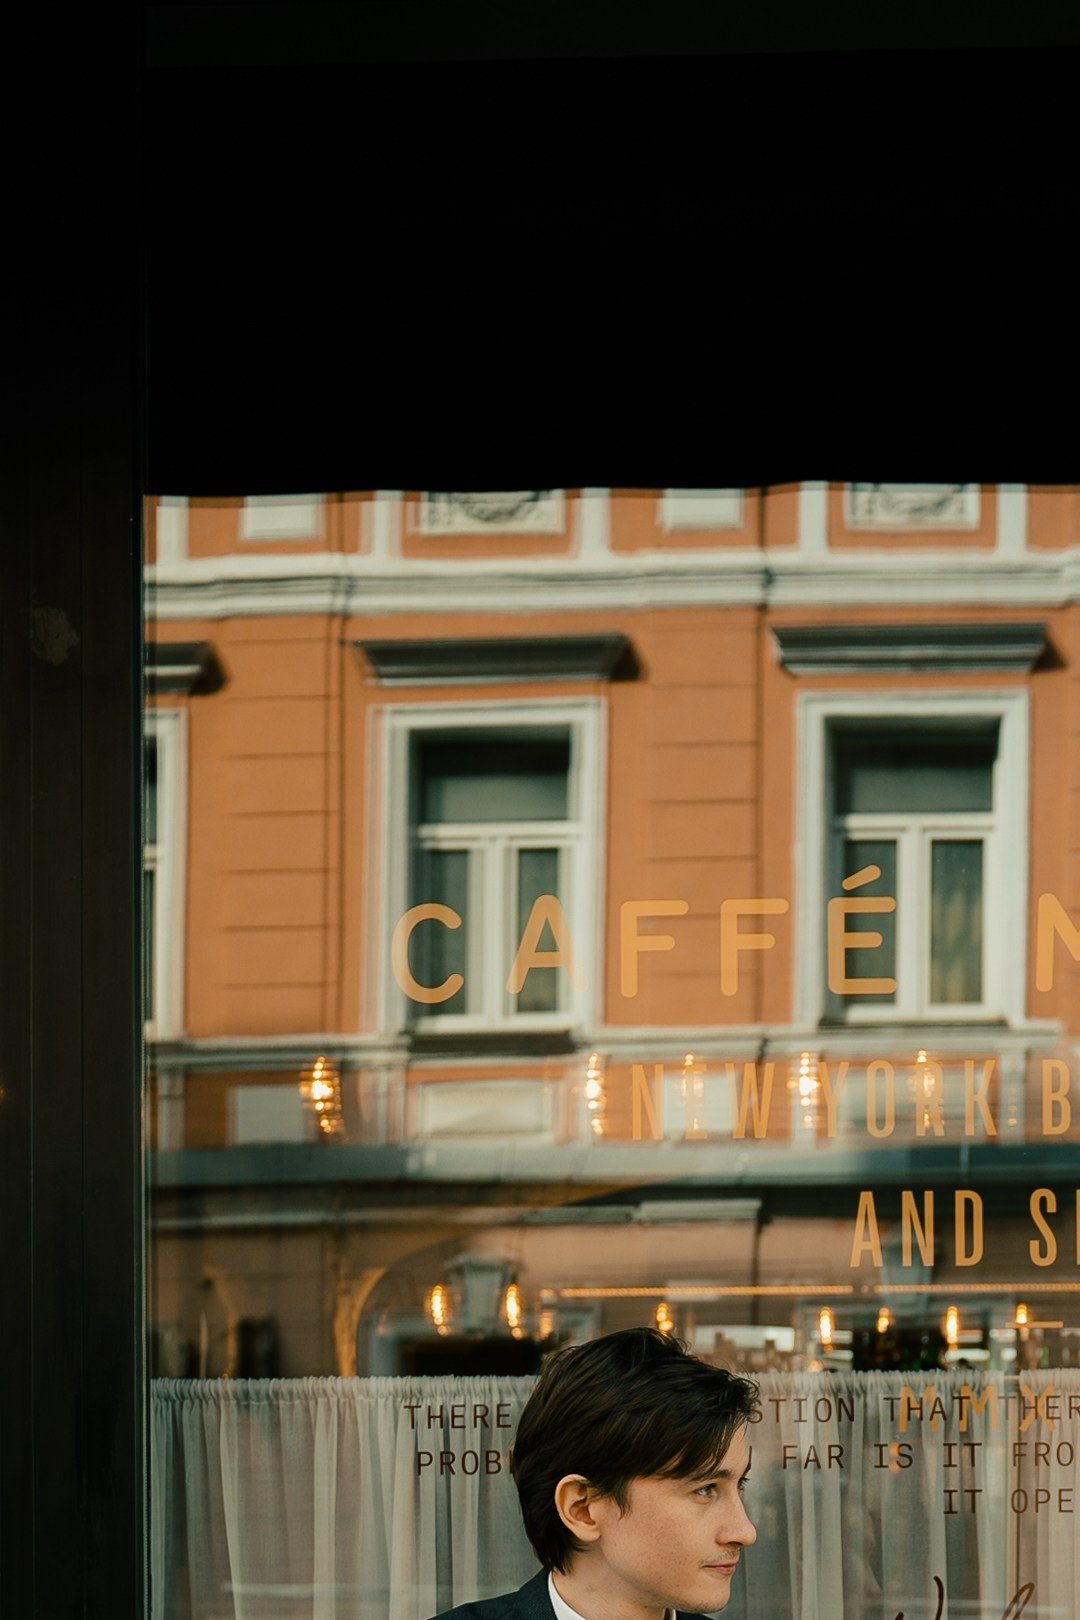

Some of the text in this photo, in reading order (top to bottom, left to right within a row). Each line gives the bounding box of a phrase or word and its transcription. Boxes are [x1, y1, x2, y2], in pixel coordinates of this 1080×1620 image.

[391, 865, 897, 1004] CAFFÉ
[632, 1061, 776, 1140] NEW
[818, 1059, 998, 1139] YORK
[850, 1190, 984, 1267] AND
[403, 1403, 512, 1430] THERE
[747, 1396, 855, 1424] STION
[883, 1396, 970, 1421] THAT
[782, 1443, 845, 1470] FAR
[874, 1442, 913, 1469] IS
[943, 1442, 983, 1468] IT
[943, 1489, 983, 1514] IT
